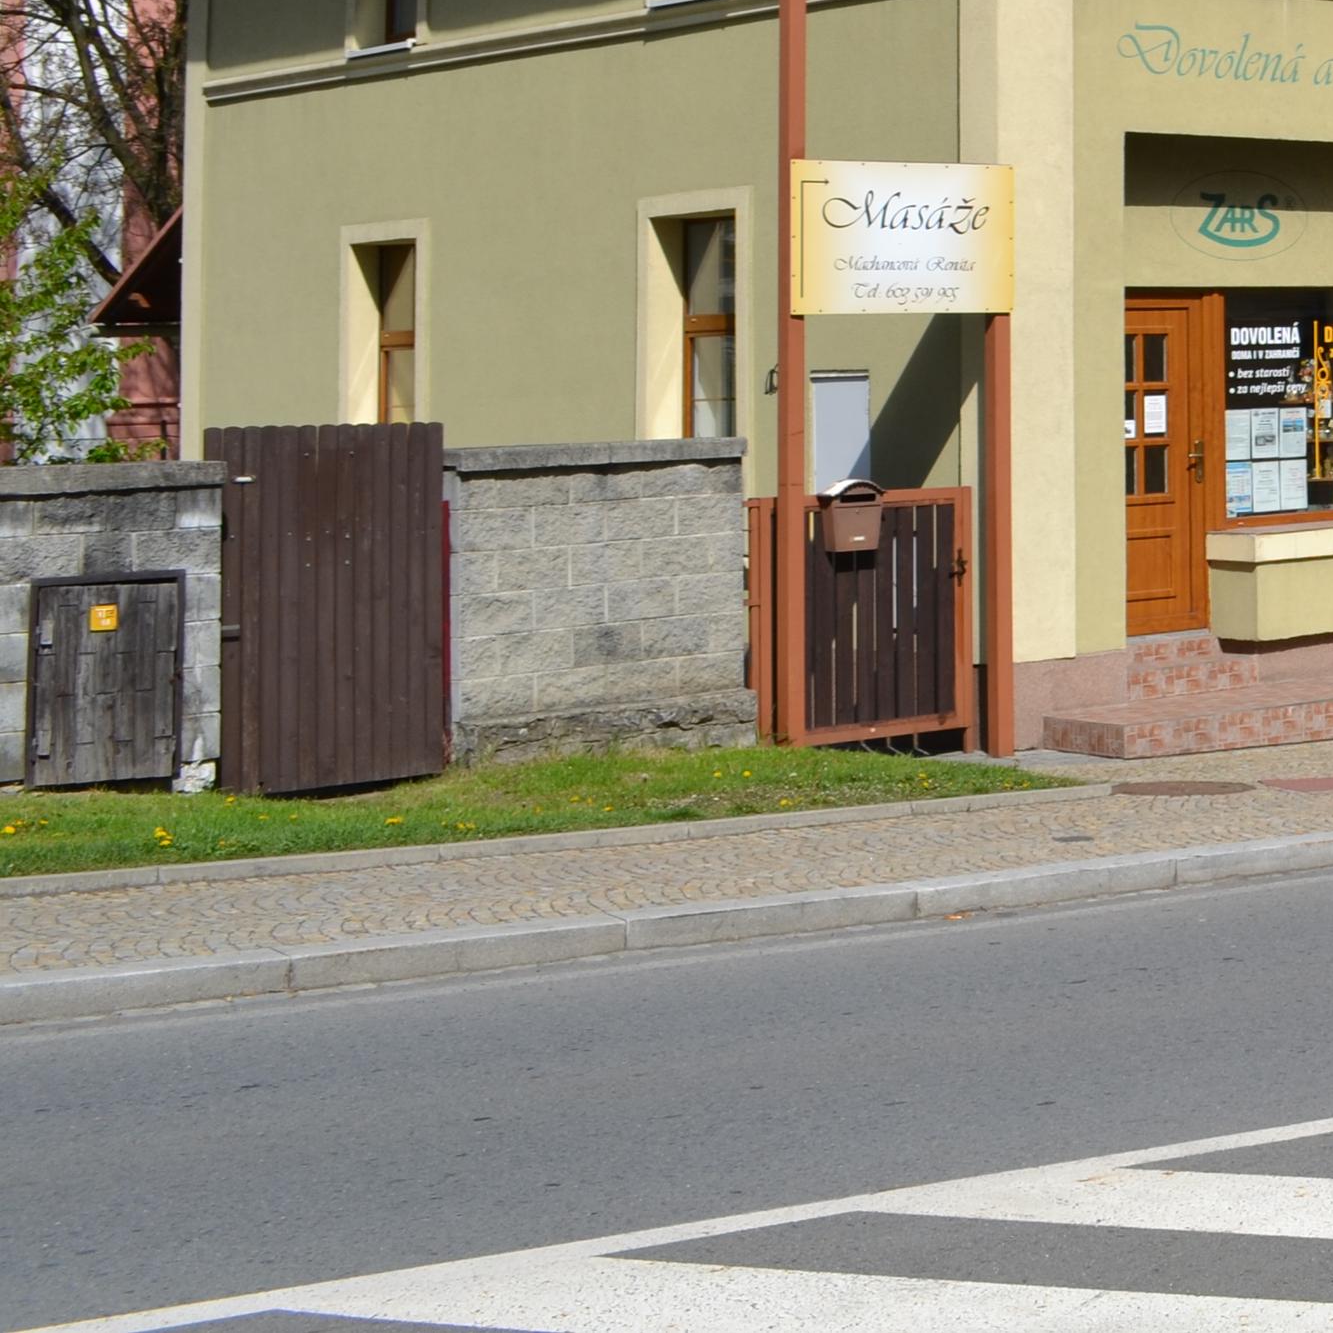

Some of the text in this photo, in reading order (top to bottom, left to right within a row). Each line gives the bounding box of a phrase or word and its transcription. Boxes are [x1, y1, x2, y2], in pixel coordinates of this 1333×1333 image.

[1117, 23, 1305, 84] Dovolená
[821, 190, 991, 235] Masáže
[1198, 192, 1281, 248] ZARS
[1230, 321, 1301, 345] DOVOLENÁ
[1258, 350, 1264, 359] V
[1237, 368, 1254, 378] bez
[1236, 385, 1248, 394] za
